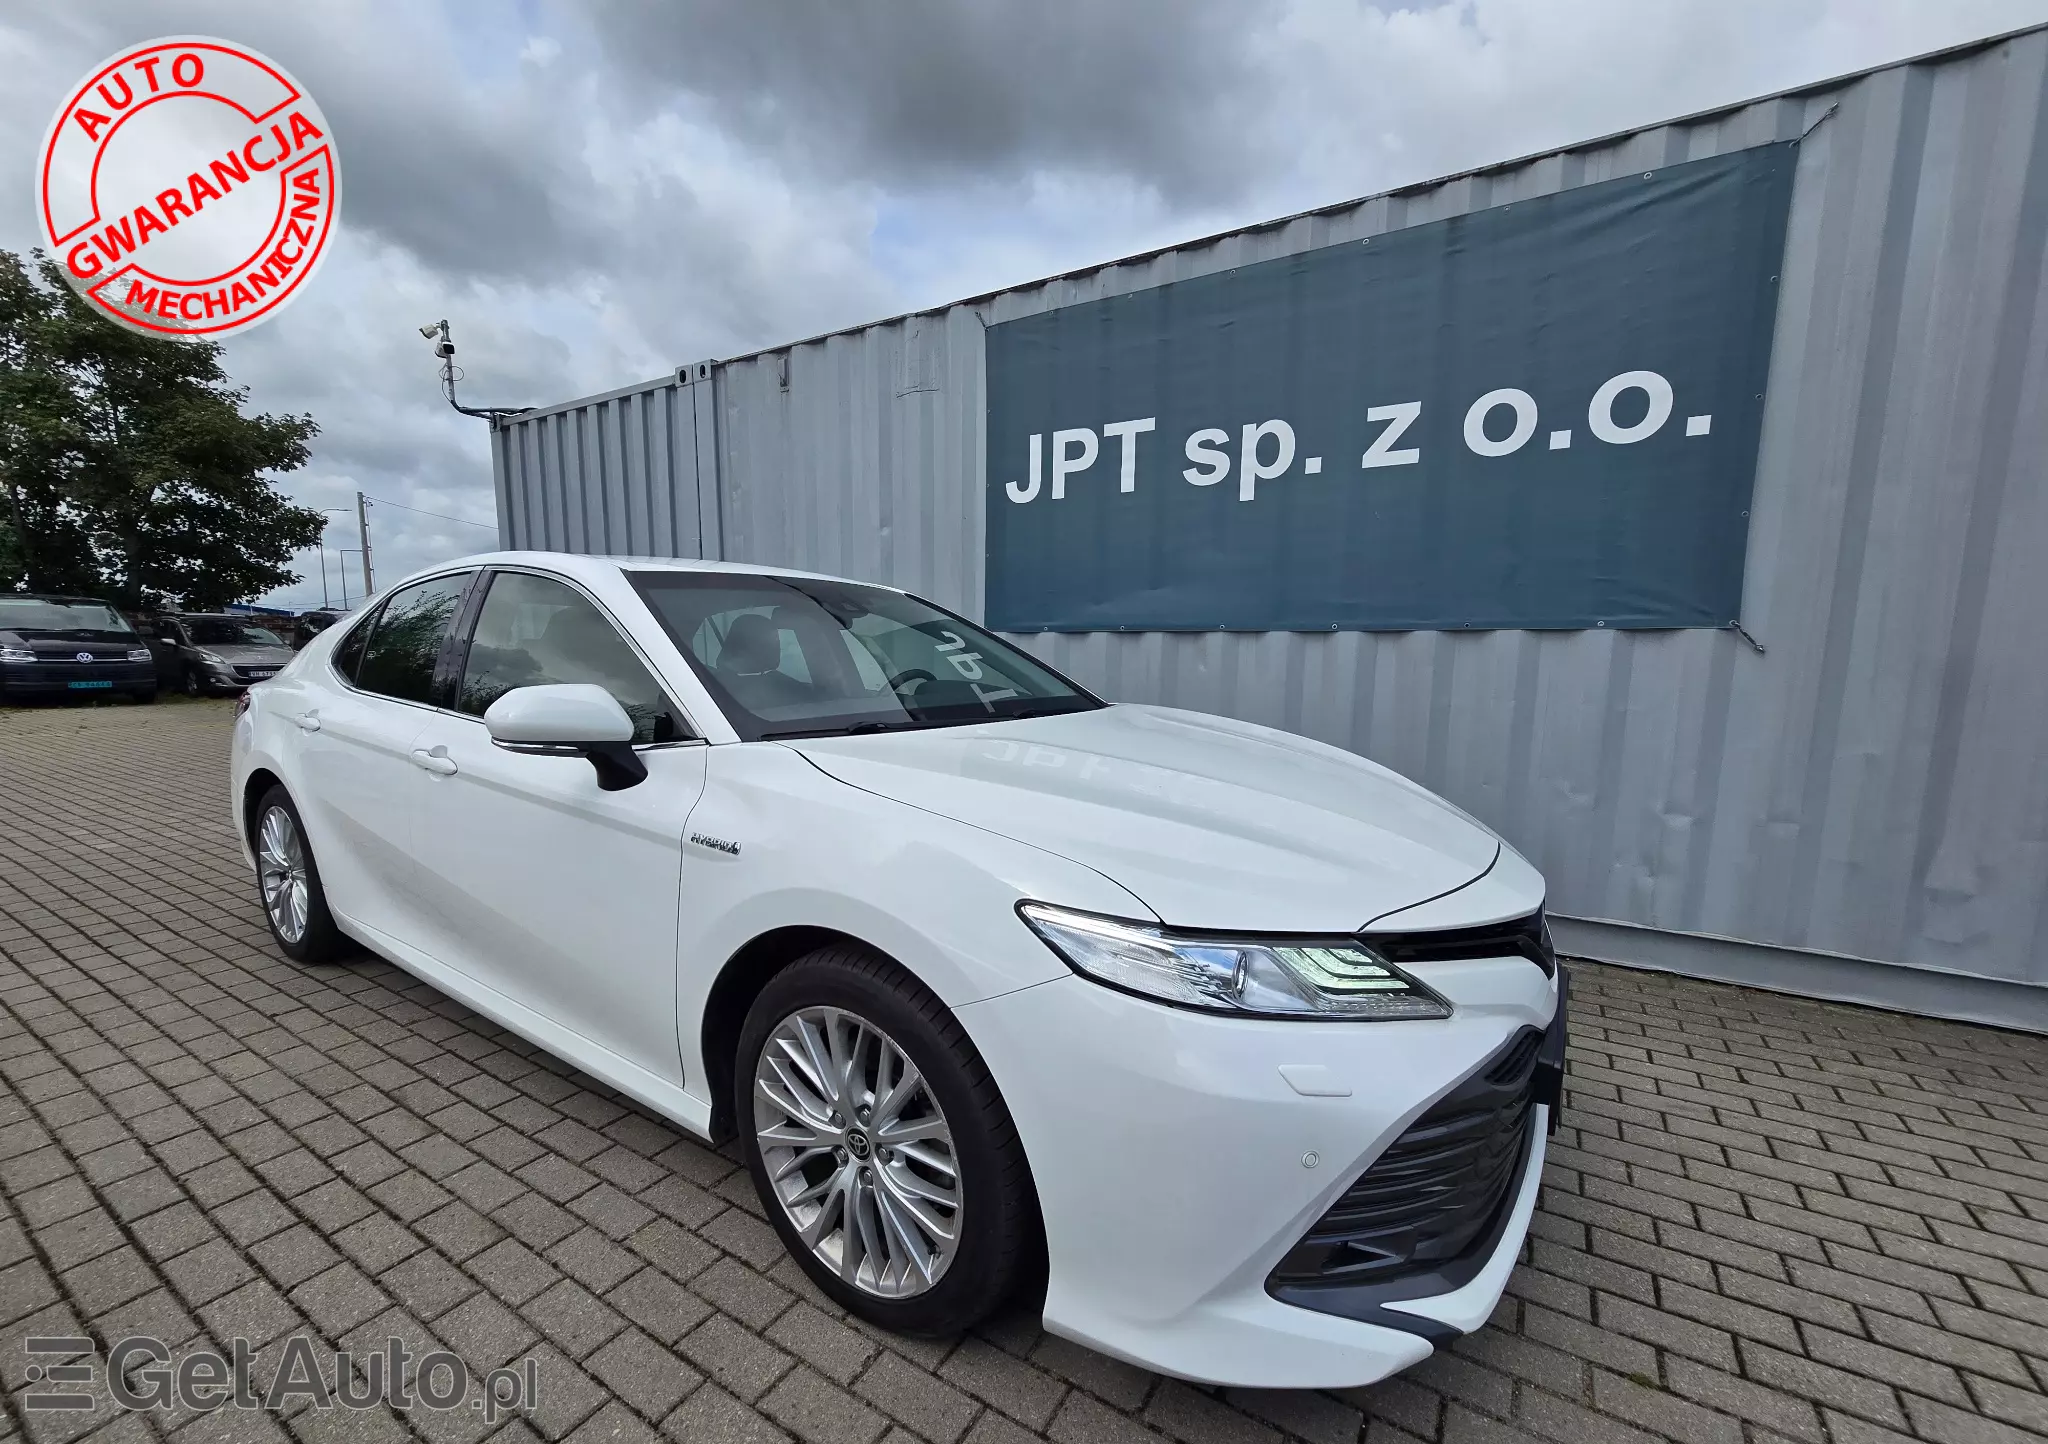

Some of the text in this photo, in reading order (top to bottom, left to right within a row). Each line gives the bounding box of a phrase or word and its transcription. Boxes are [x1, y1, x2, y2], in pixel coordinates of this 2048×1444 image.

[1006, 371, 1711, 503] JPT sp. z o.o.
